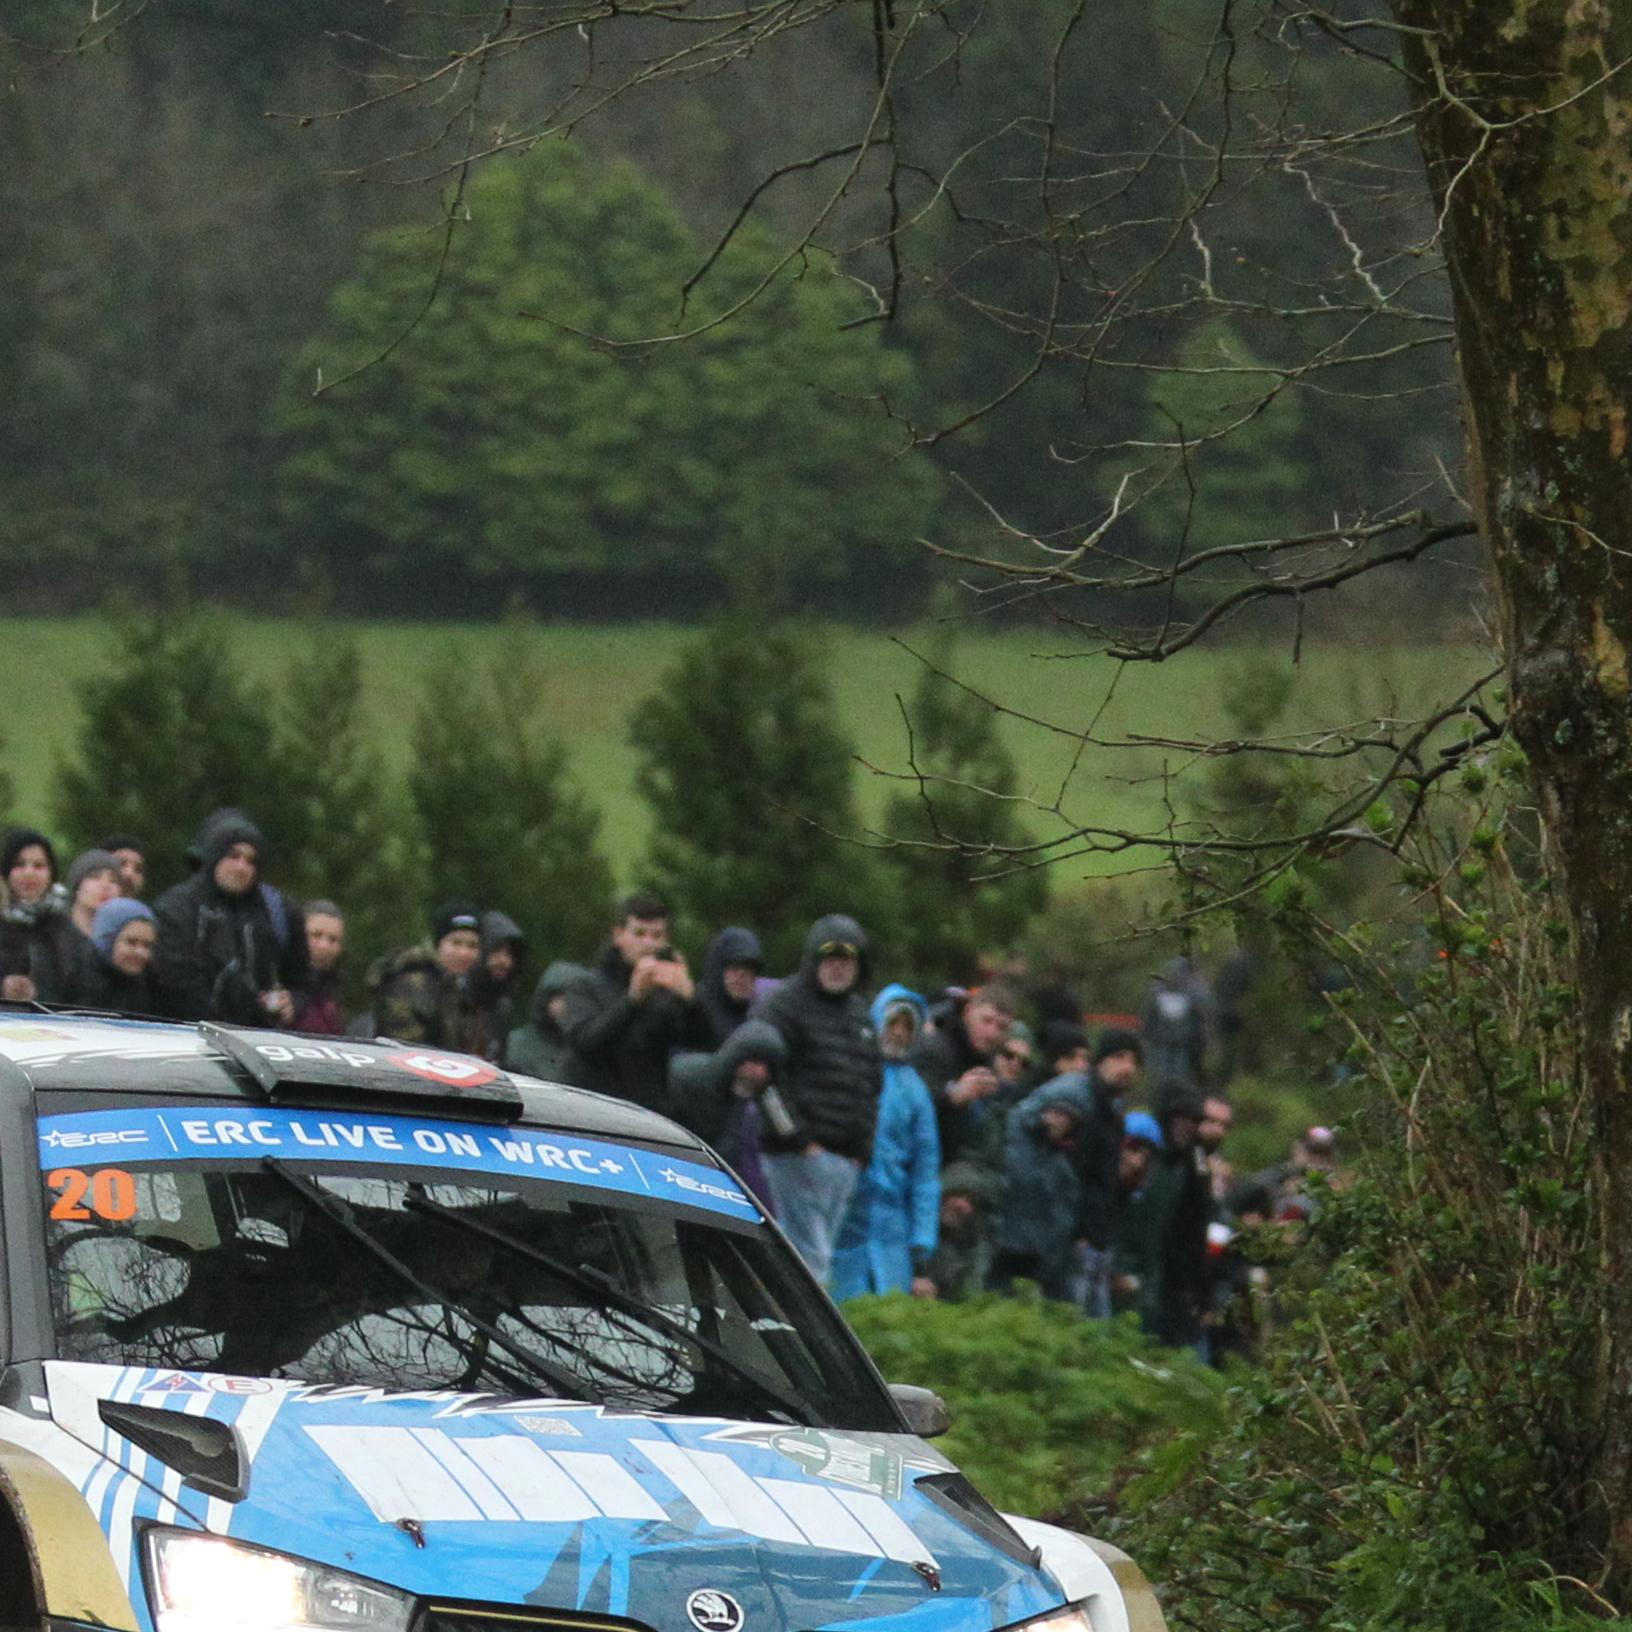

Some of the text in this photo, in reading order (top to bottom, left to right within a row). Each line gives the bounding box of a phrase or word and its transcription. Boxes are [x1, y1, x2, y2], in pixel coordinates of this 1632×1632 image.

[255, 1045, 376, 1068] galp
[180, 1120, 625, 1175] ERC LIVE ON WRC+
[48, 1168, 137, 1221] 20
